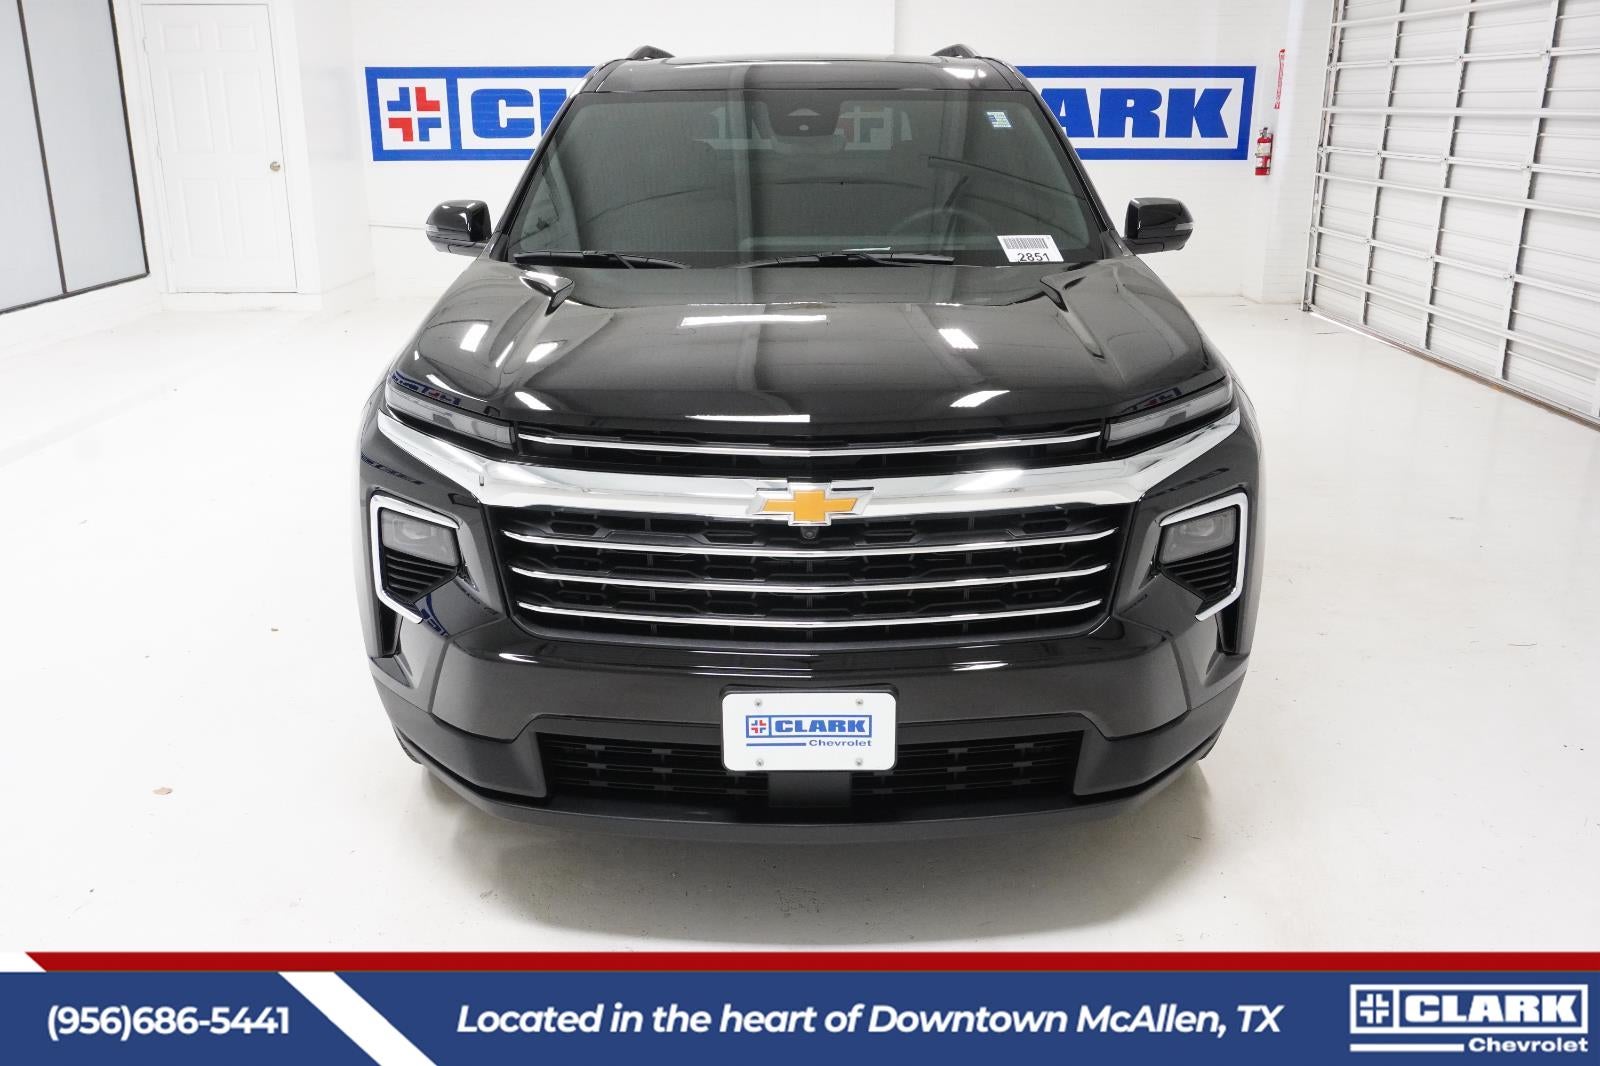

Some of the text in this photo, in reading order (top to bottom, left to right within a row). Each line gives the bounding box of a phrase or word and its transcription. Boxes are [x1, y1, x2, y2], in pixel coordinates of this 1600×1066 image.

[1017, 252, 1050, 262] 2851
[775, 720, 865, 733] CLARK
[809, 739, 872, 747] Chevrolet
